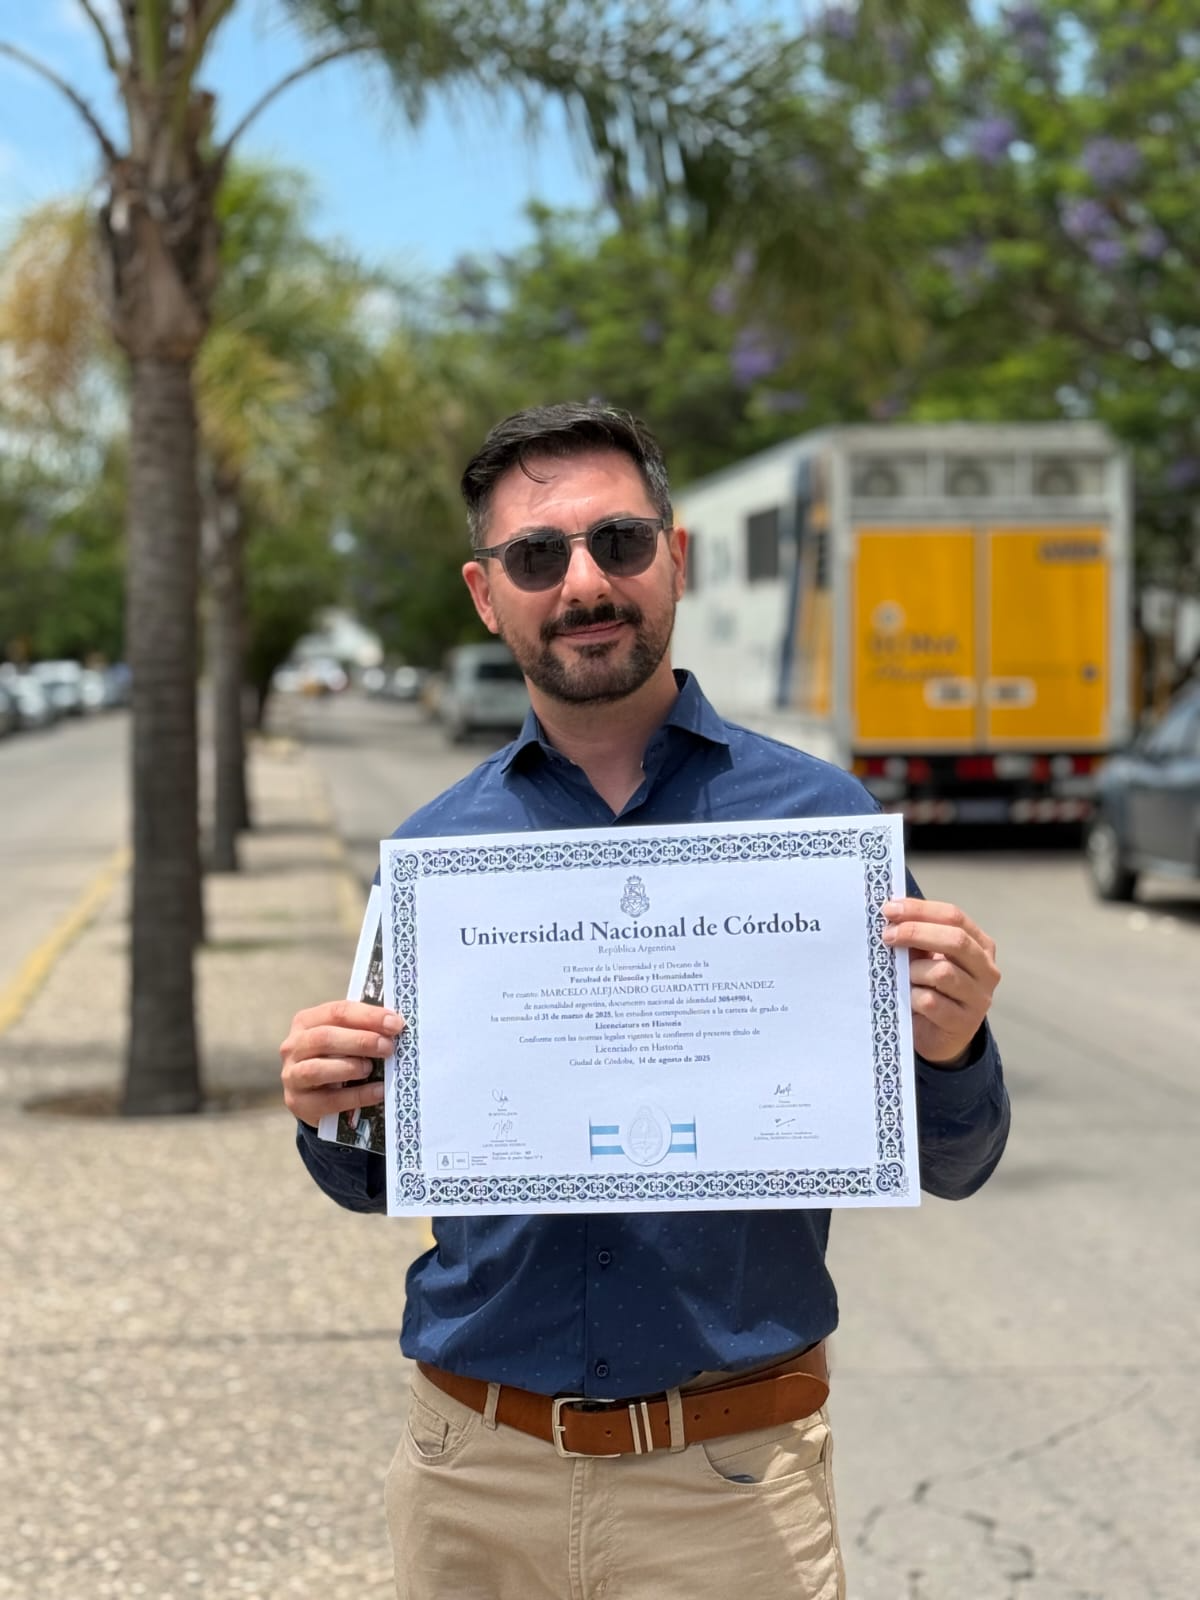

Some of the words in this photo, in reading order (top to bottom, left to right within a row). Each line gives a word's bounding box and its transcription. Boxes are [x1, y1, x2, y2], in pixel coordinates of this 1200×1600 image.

[460, 921, 584, 945] Universidad
[591, 917, 687, 940] Nacional
[692, 916, 718, 936] de
[723, 912, 821, 935] Córdoba
[598, 945, 636, 956] República
[638, 944, 675, 954] Argentina
[652, 972, 703, 980] Humanidades
[541, 988, 588, 997] MARCELO
[590, 985, 648, 997] ALEJANDRO
[651, 983, 709, 993] GUARDATTI
[712, 981, 775, 990] FERNANDEZ
[533, 1001, 573, 1009] nacionalidad
[686, 996, 716, 1004] identidad
[759, 1005, 779, 1014] grado
[568, 1034, 576, 1042] las
[604, 1033, 625, 1042] legales
[627, 1033, 654, 1041] vigentes
[703, 1030, 731, 1038] presente
[595, 1044, 638, 1053] Licenciado
[652, 1043, 683, 1051] Historia
[569, 1058, 593, 1066] Ciudad
[658, 1056, 682, 1064] agosto
